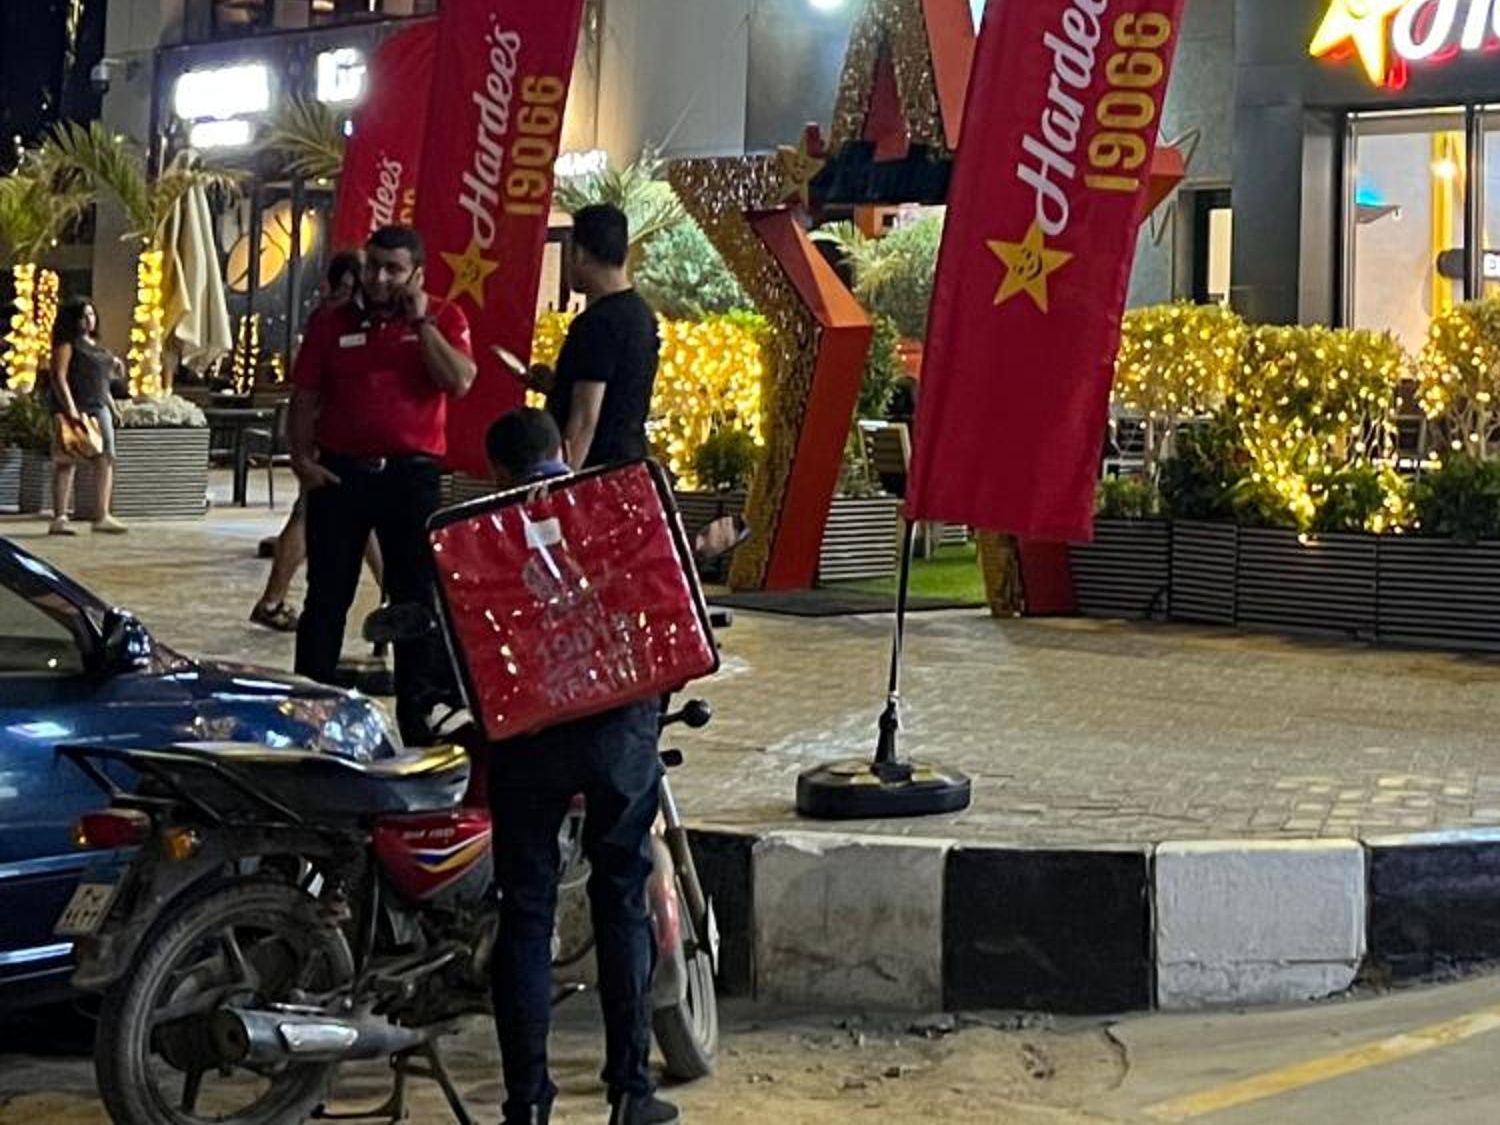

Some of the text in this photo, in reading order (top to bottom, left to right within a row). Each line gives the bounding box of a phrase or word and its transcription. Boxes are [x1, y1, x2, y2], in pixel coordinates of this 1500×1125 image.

[458, 23, 522, 250] Hardee's
[503, 75, 566, 217] 19066
[1083, 10, 1172, 193] 19066
